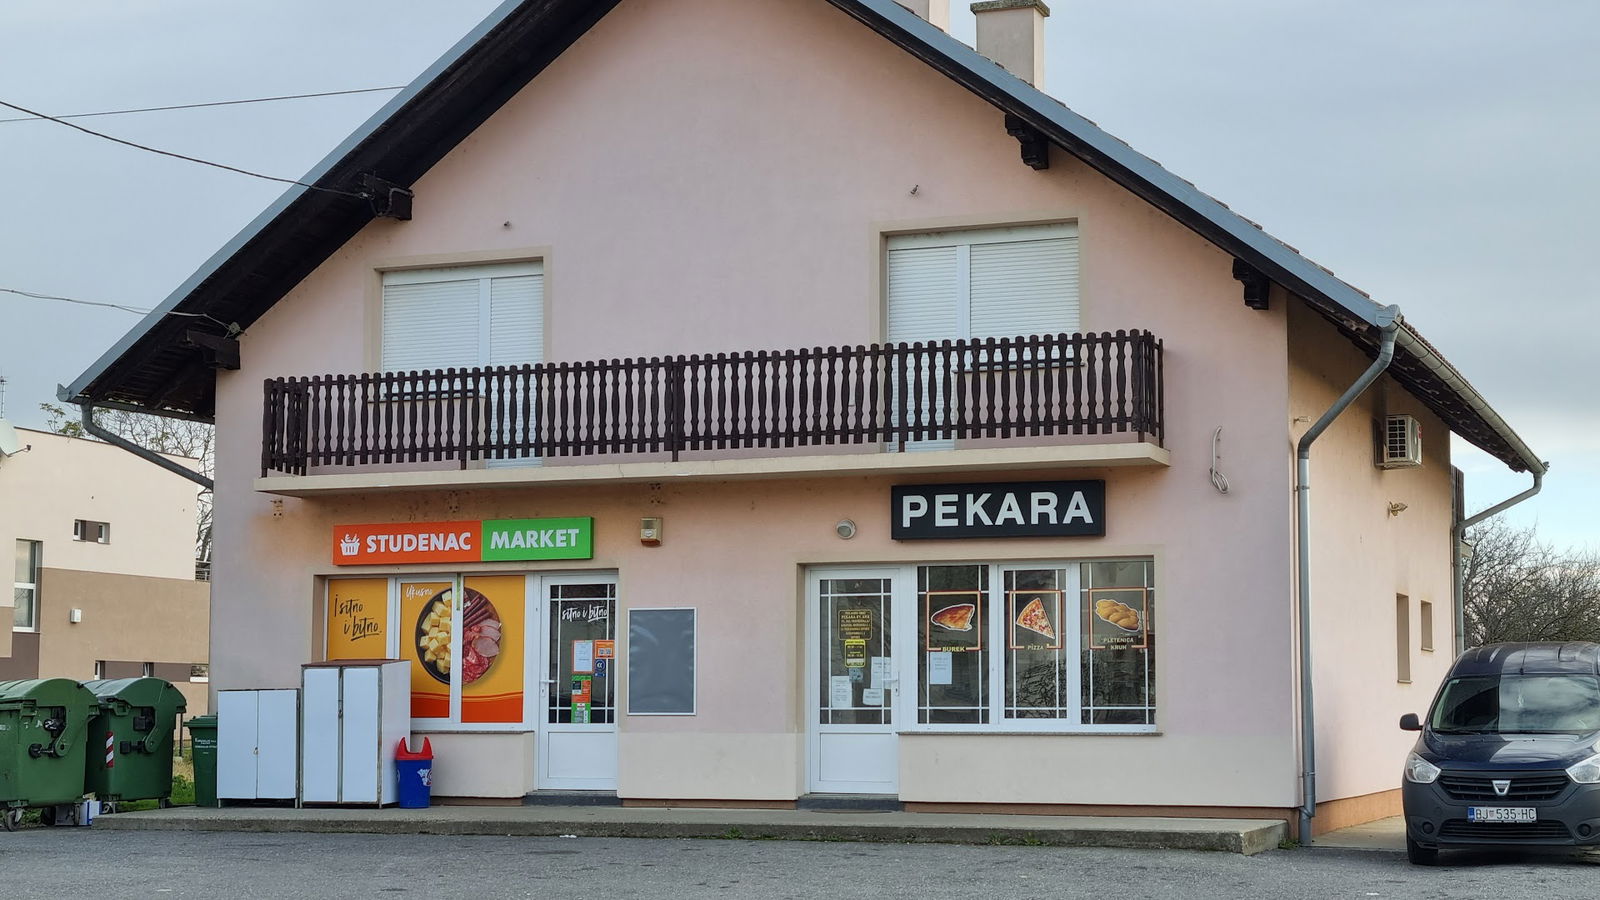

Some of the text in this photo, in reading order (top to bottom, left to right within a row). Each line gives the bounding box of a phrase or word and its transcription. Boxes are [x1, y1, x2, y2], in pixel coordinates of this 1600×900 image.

[902, 491, 1094, 528] PEKARA
[366, 528, 579, 553] STUDENAC MARKET
[340, 599, 364, 618] sitno
[562, 607, 580, 622] sitno
[588, 604, 608, 622] bitno
[343, 620, 350, 635] i
[1475, 808, 1488, 820] BJ
